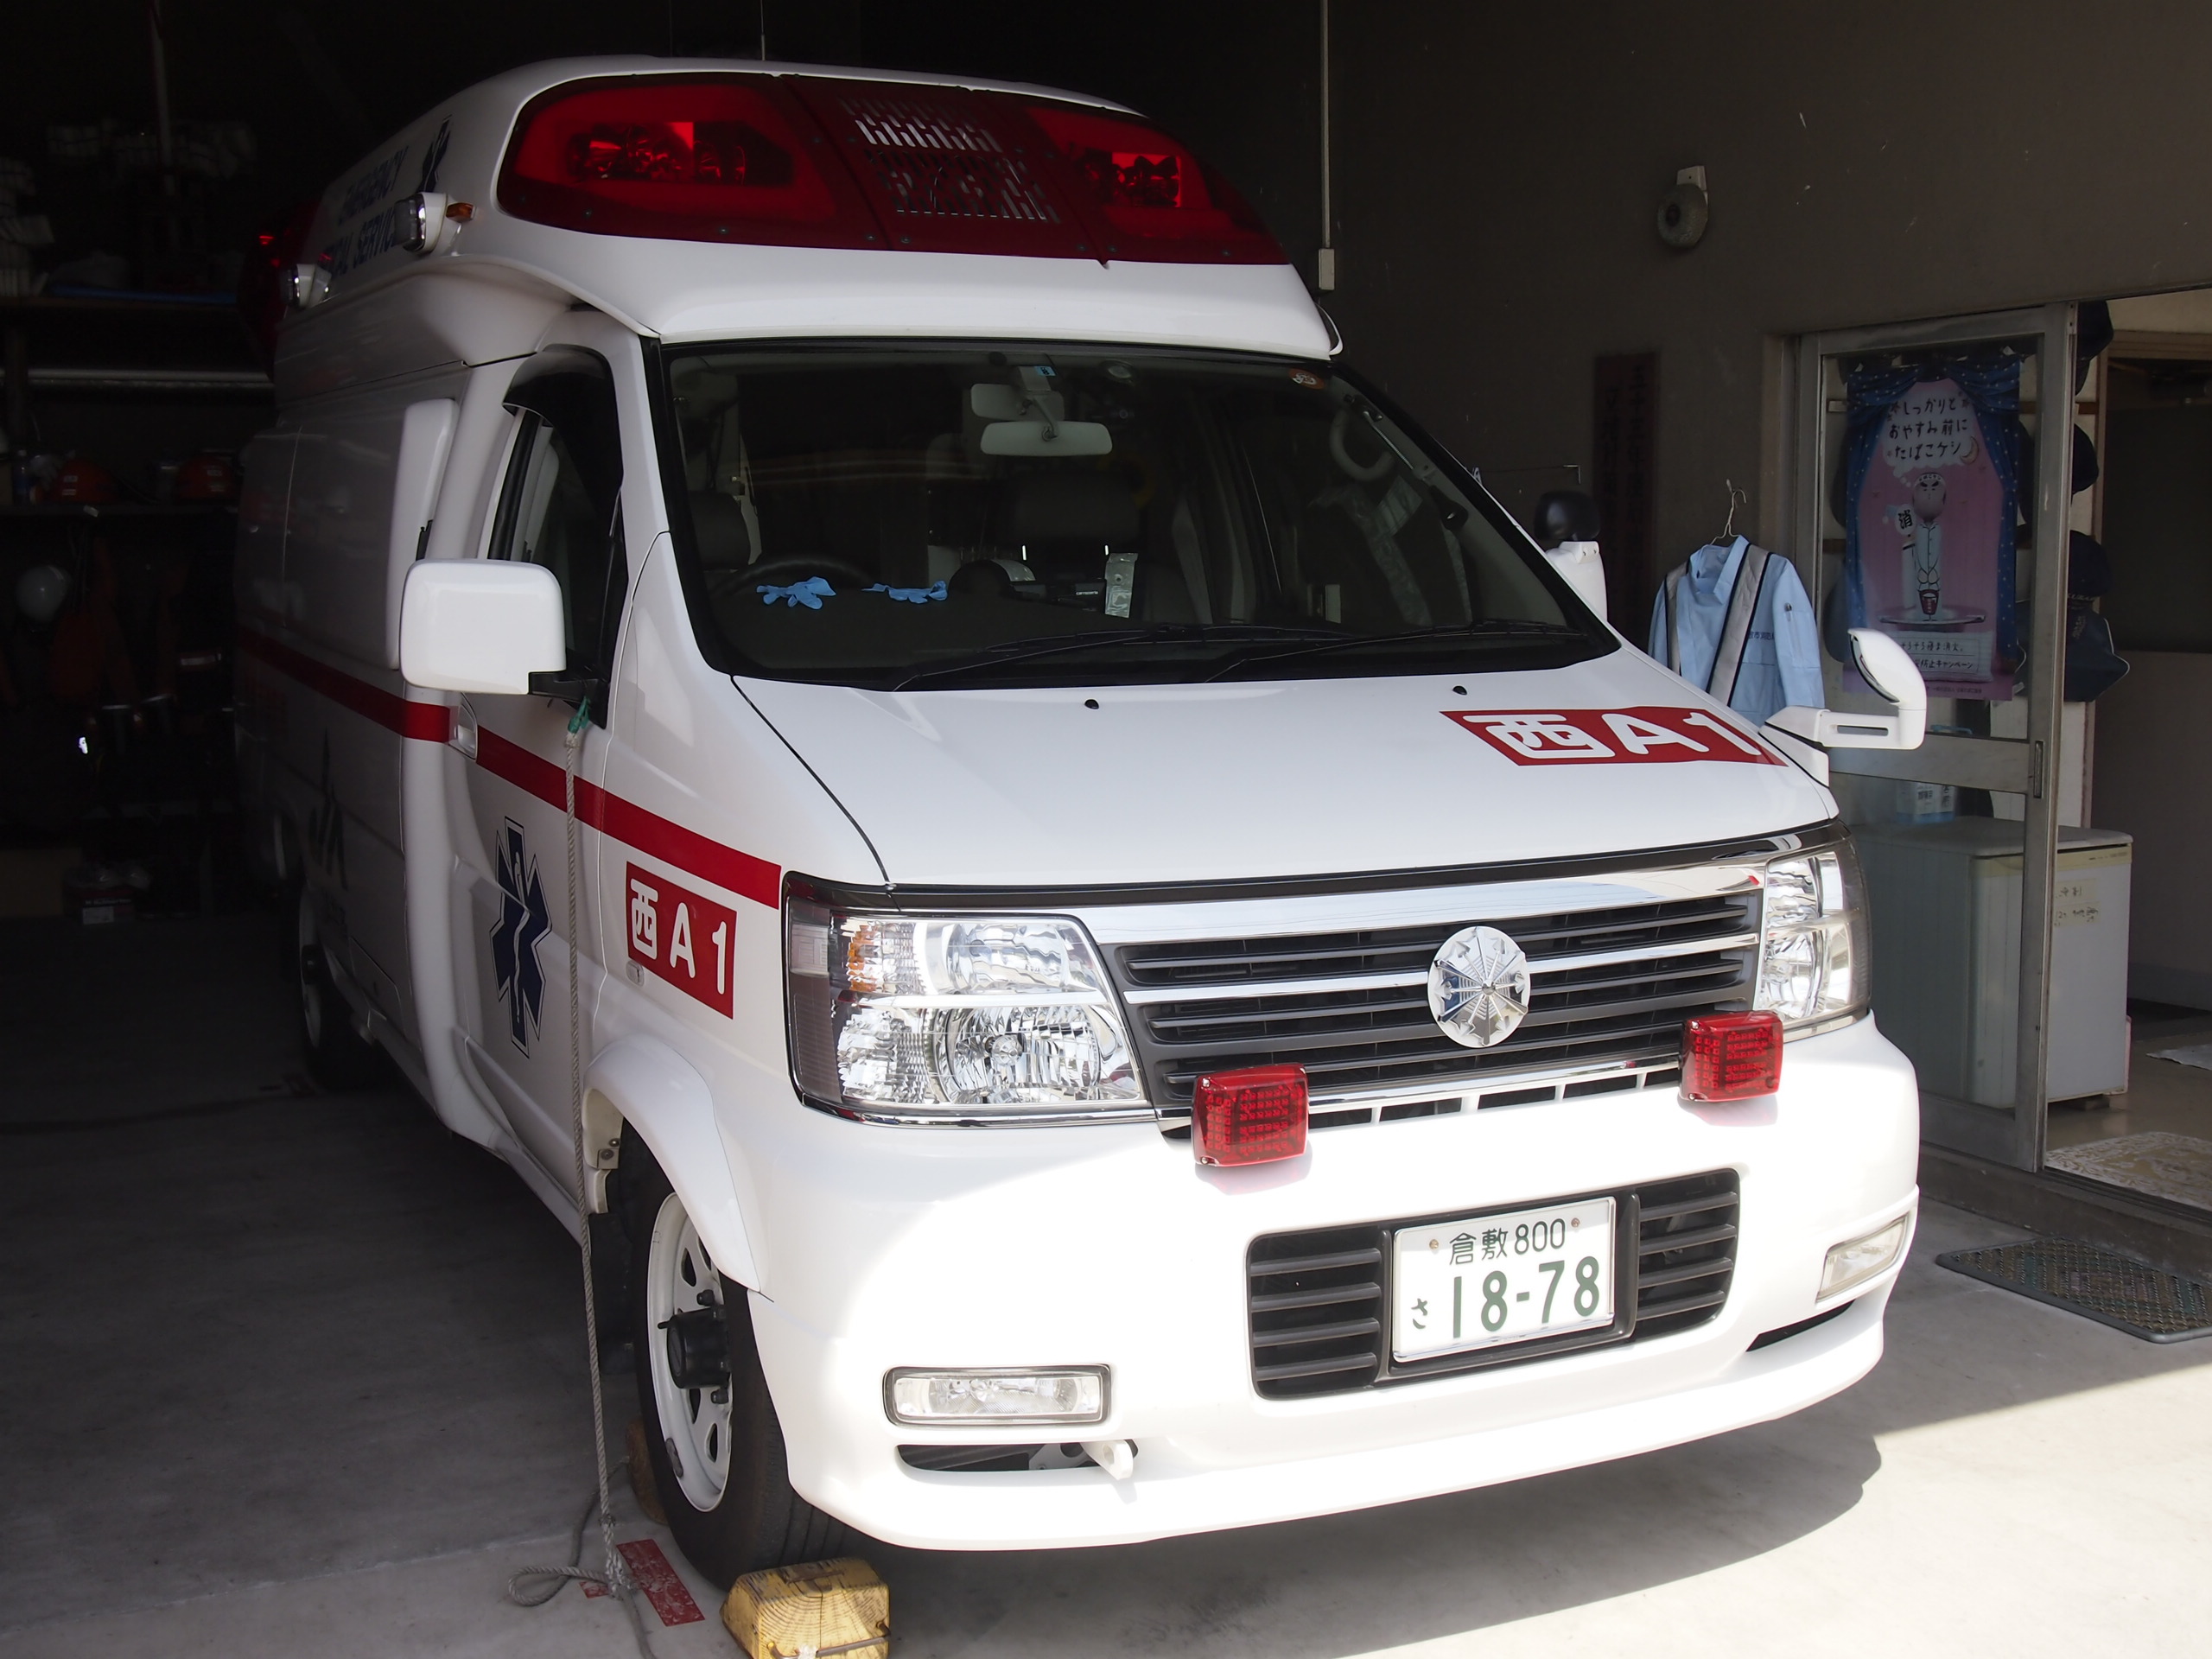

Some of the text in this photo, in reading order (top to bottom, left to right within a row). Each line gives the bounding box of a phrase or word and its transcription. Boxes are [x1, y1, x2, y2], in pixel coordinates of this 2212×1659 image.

[1904, 397, 1956, 415] しっかりと
[1889, 419, 1968, 440] おやすみ前に
[1411, 1255, 1599, 1339] さ 18-78
